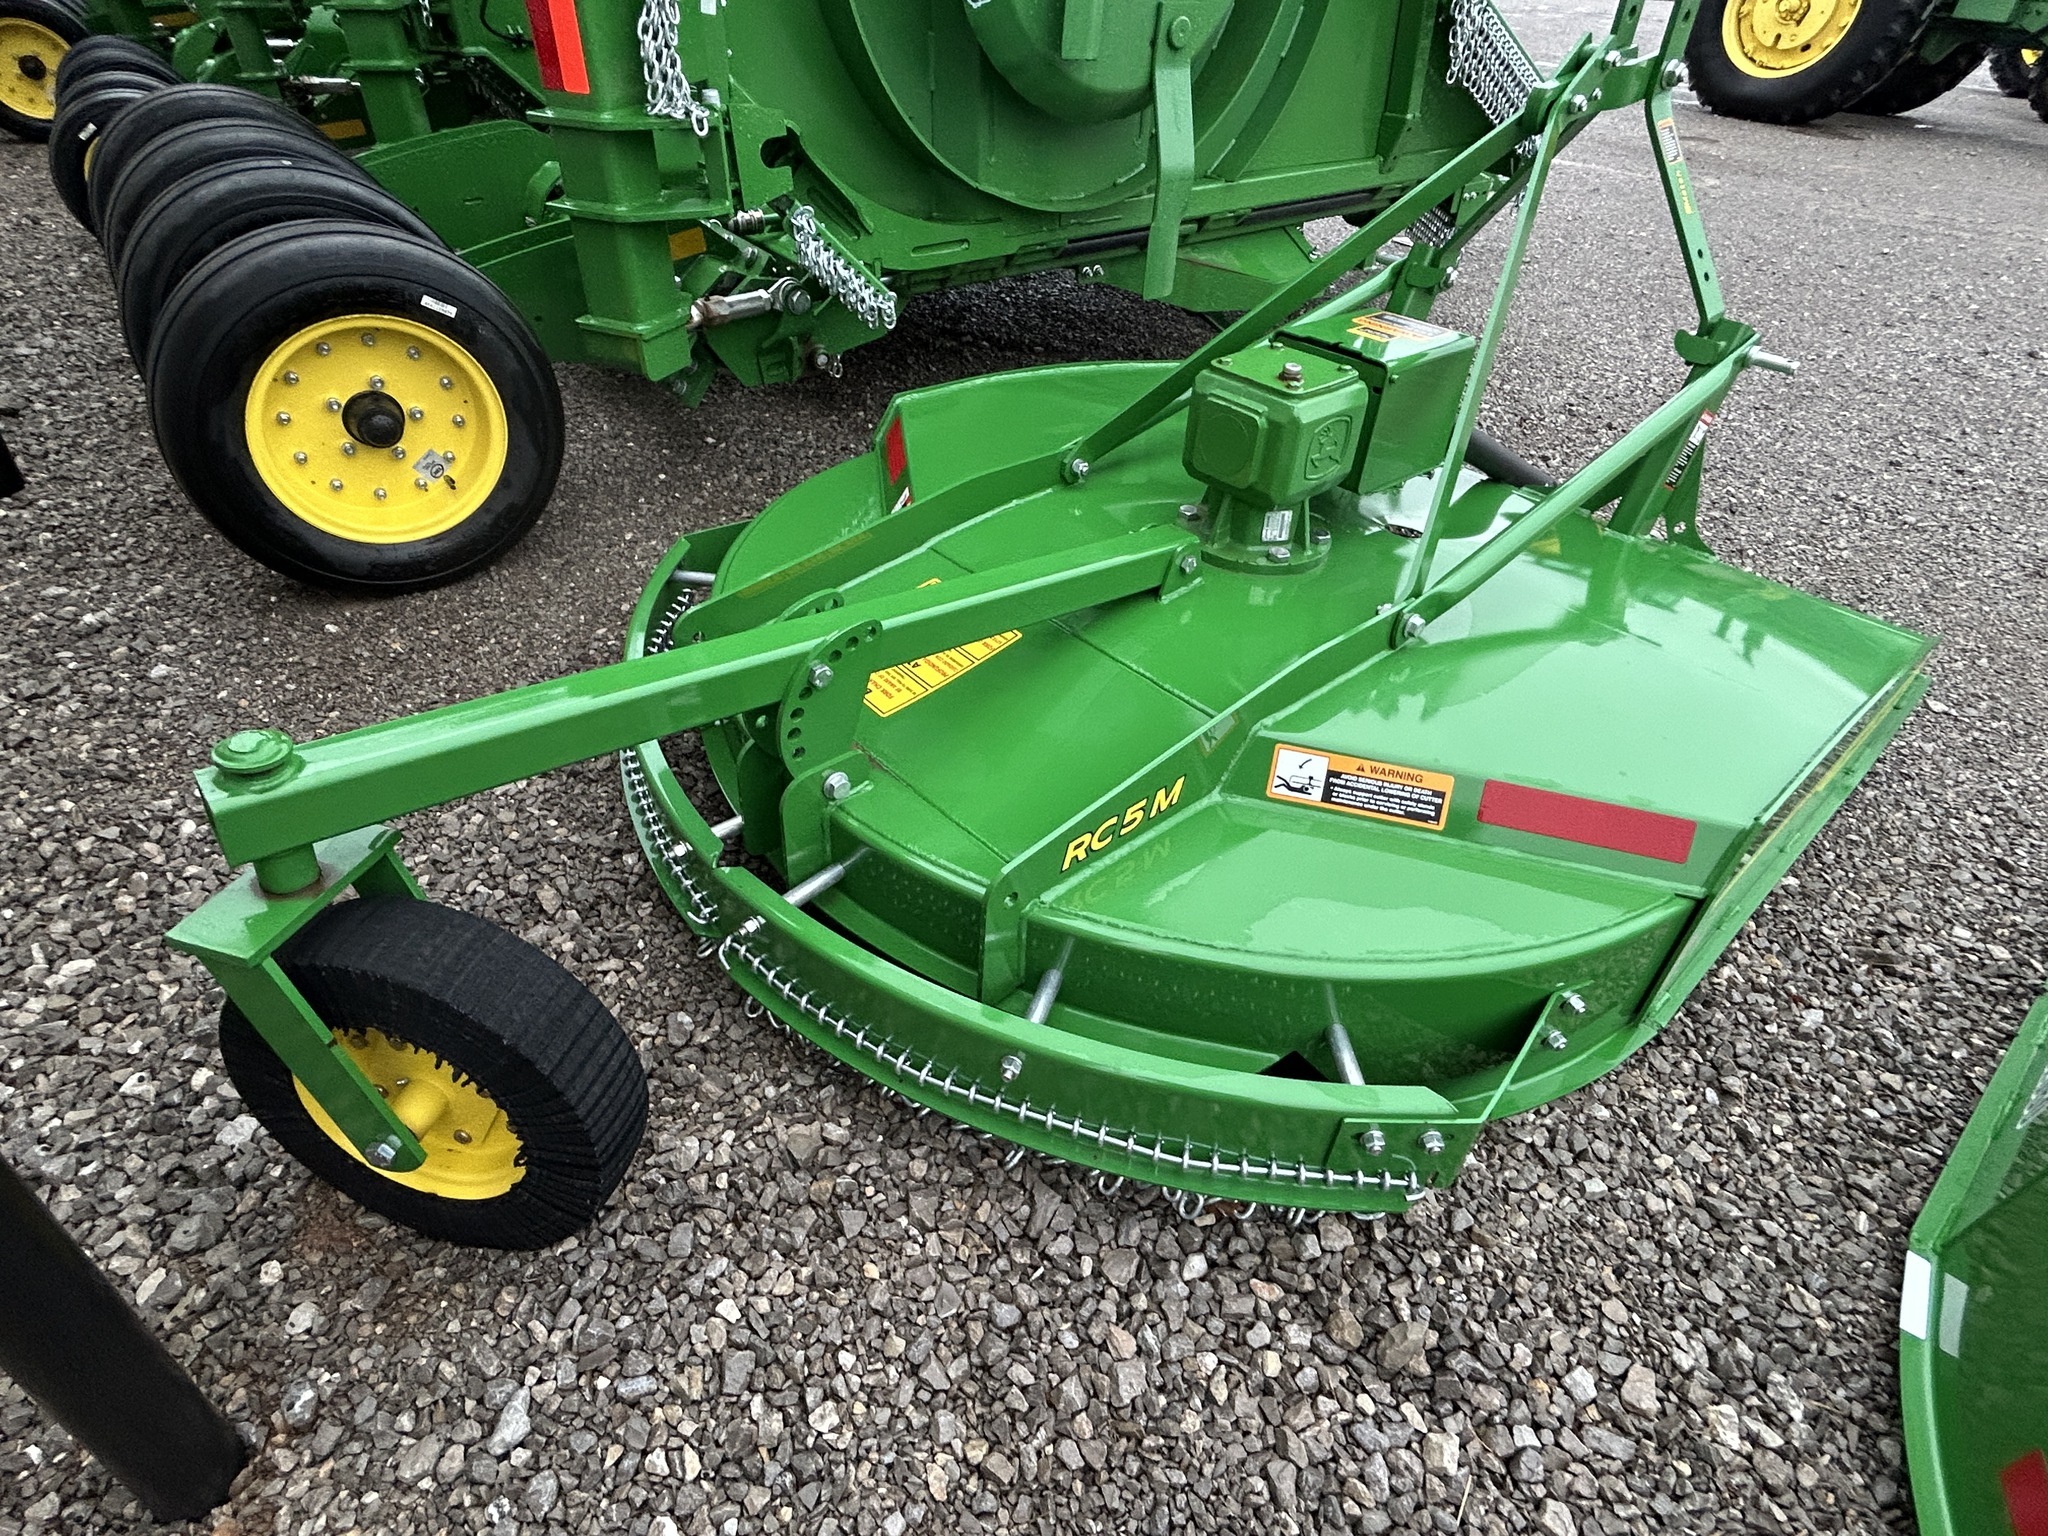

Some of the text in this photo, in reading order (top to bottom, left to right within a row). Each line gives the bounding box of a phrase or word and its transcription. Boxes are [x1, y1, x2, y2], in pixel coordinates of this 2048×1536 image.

[1370, 766, 1423, 783] WARNING
[1346, 781, 1380, 792] ACCIDENTAL
[1381, 788, 1410, 798] LOWERING
[1420, 795, 1442, 804] CUTTER
[1358, 777, 1382, 786] SERIOUS
[1413, 787, 1432, 795] DEATH
